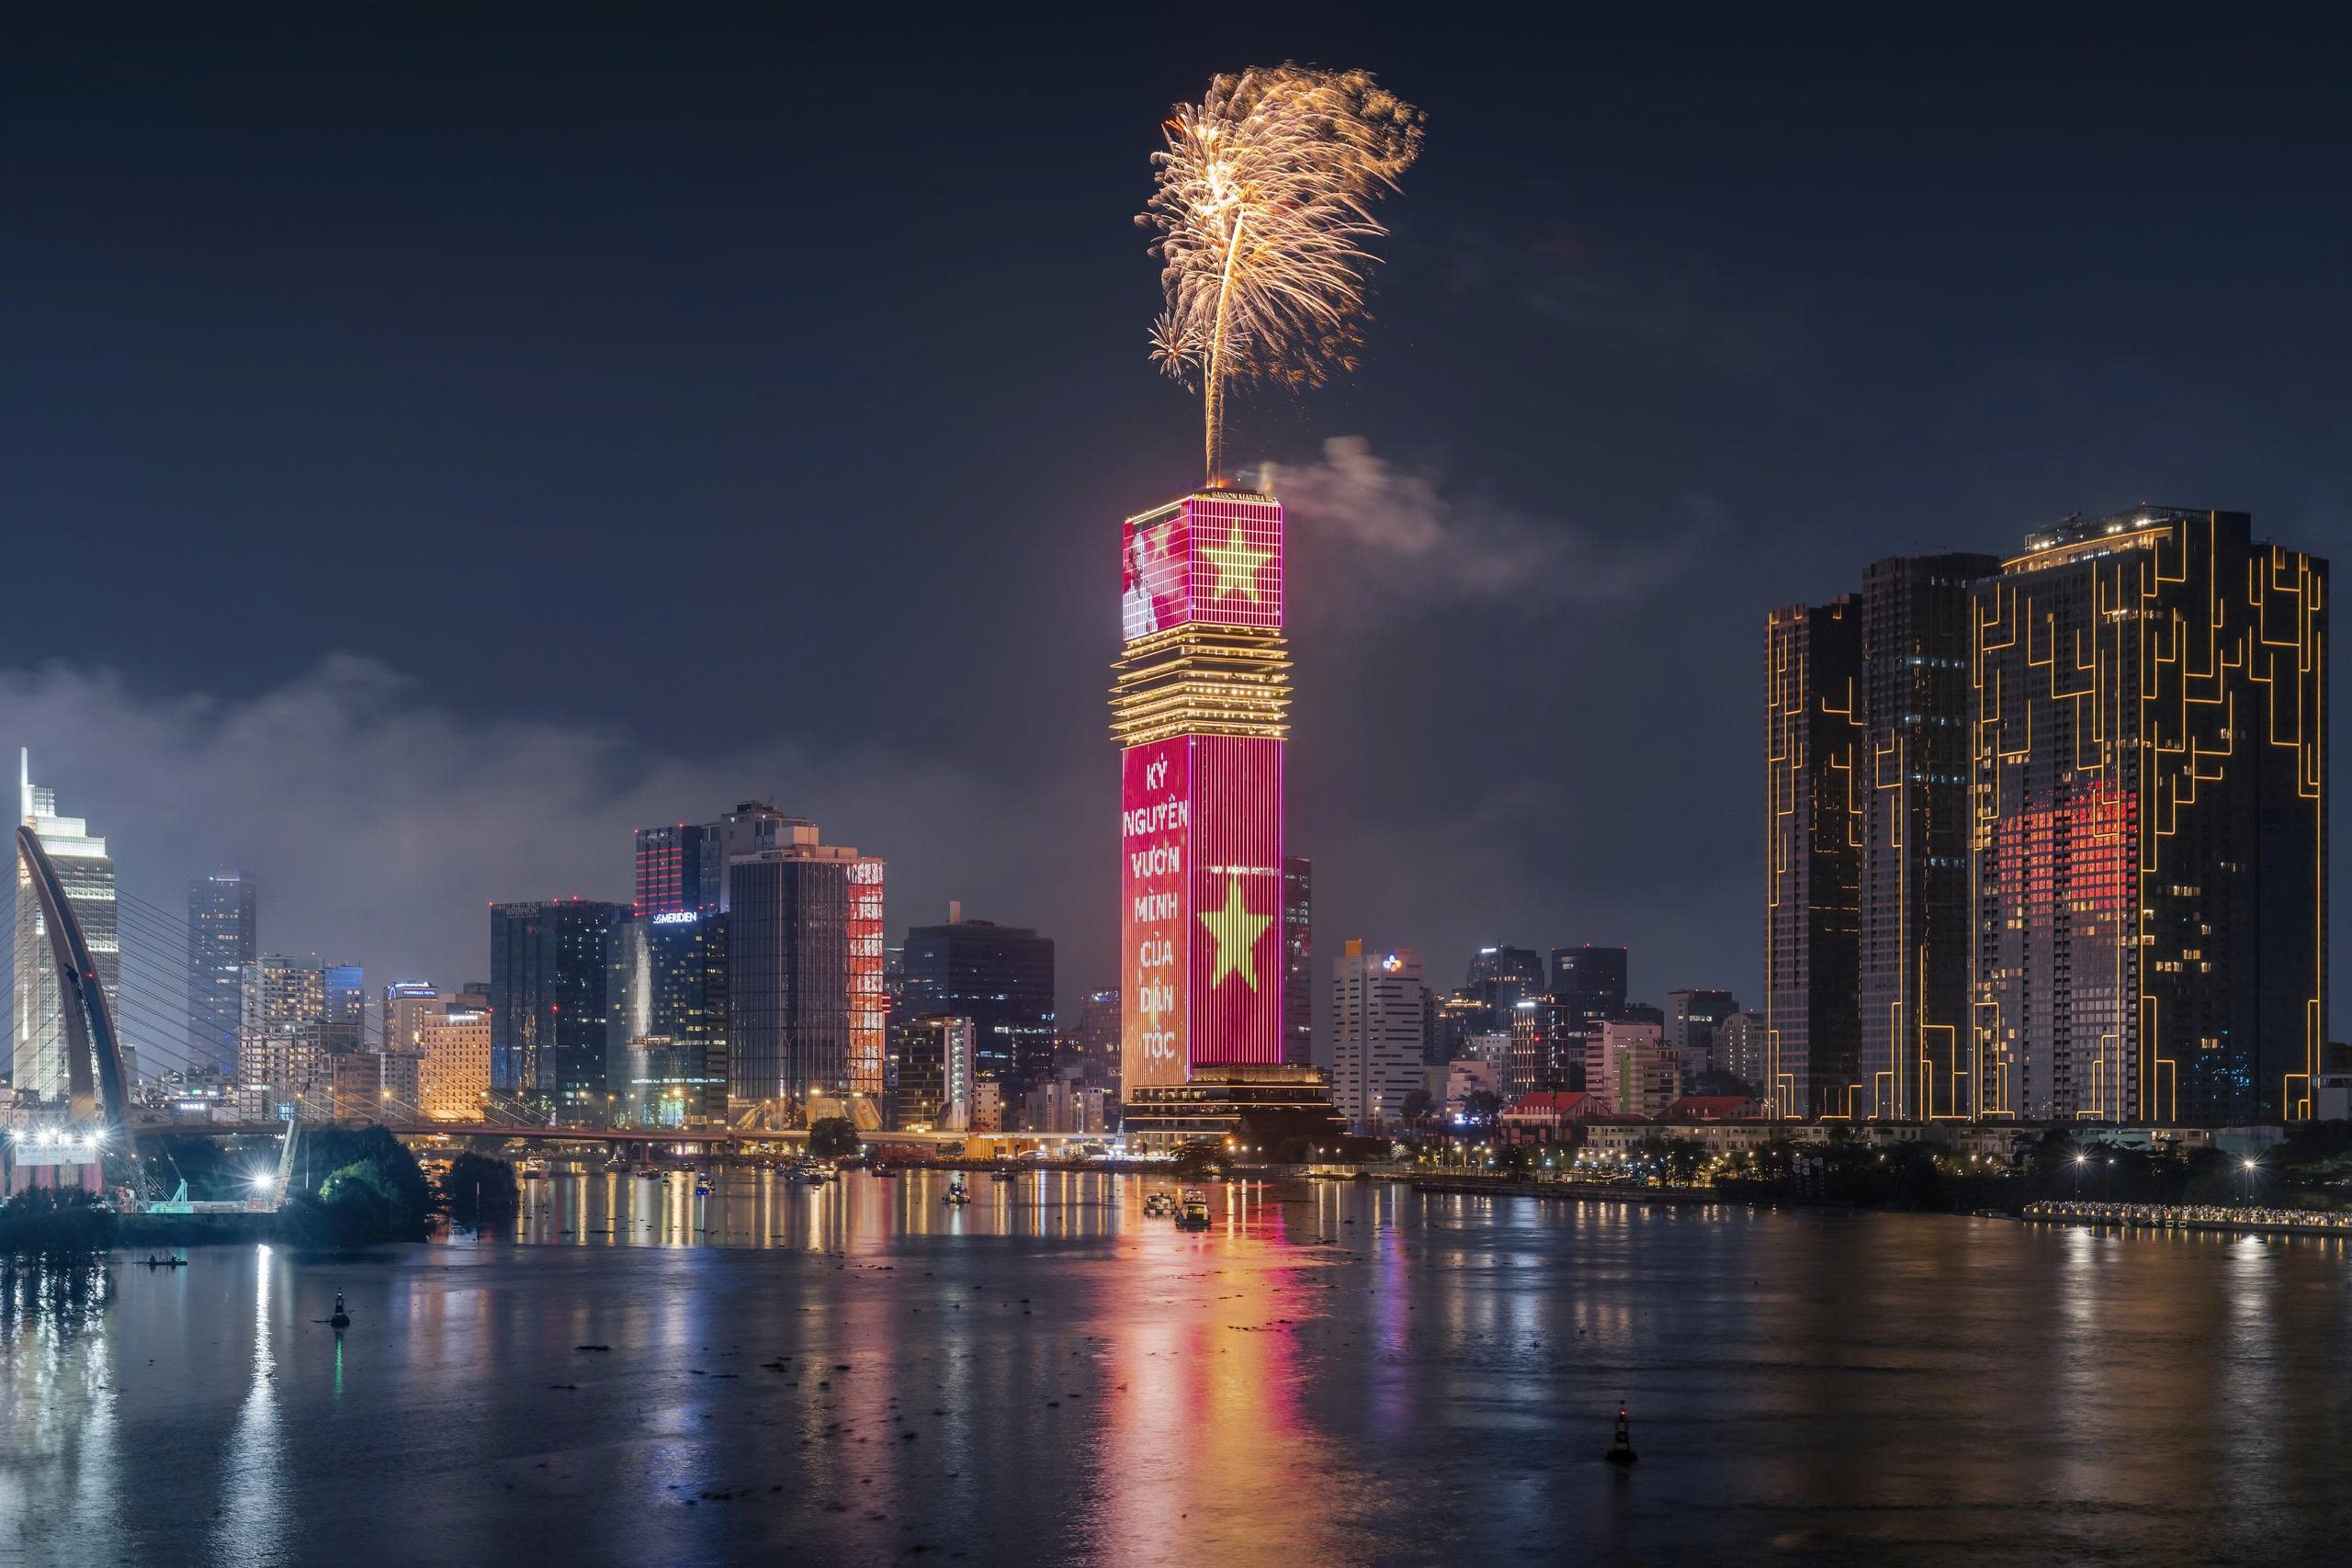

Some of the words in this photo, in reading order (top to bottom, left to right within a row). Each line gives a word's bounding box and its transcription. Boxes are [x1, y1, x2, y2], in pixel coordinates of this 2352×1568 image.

[1211, 491, 1238, 501] SAIGON
[1238, 492, 1265, 502] MARINA
[1124, 793, 1188, 838] NGUYÊN
[662, 911, 697, 924] MERIDIEN
[1135, 886, 1178, 923] MÌNH
[1140, 931, 1174, 968] CỦA
[1140, 976, 1174, 1014] DÂN
[1142, 1021, 1176, 1066] TỘC
